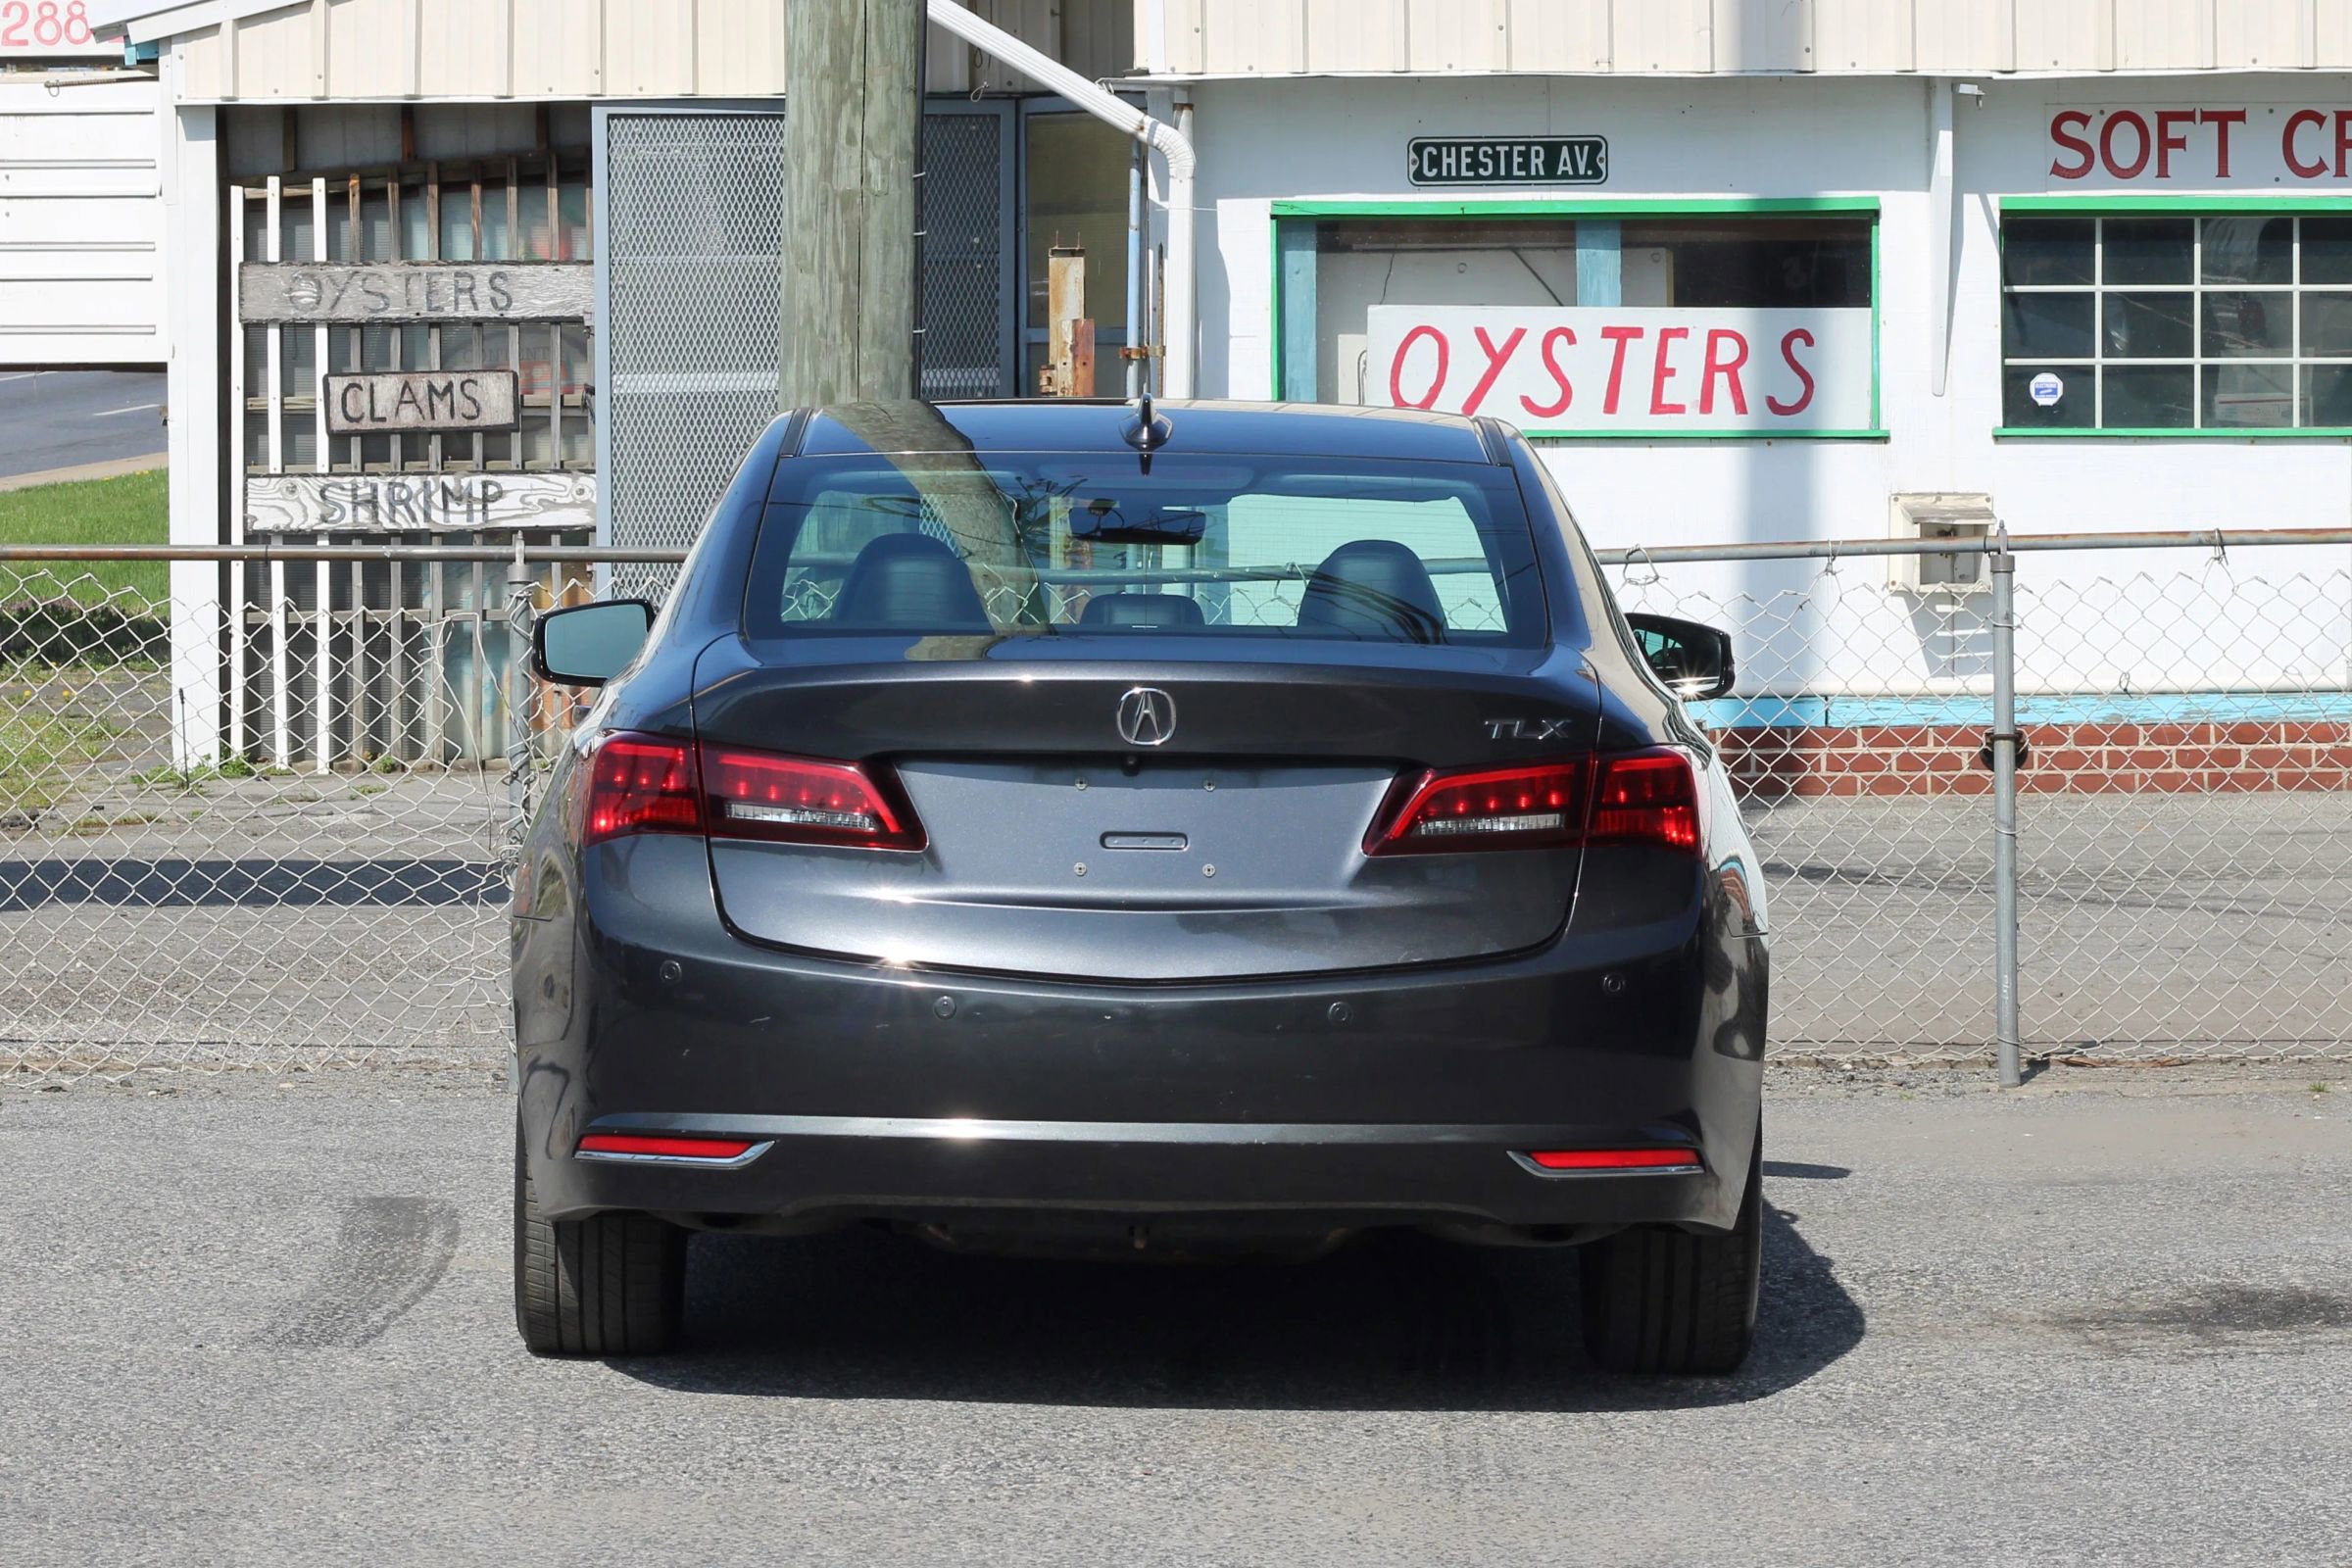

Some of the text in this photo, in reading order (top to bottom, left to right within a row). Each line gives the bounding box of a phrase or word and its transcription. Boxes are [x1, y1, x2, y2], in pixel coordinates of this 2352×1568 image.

[1, 0, 124, 46] 288
[1422, 145, 1592, 177] CHESTER AV.
[2049, 107, 2247, 179] SOFT
[287, 270, 514, 313] OYSTERS
[1389, 324, 1815, 418] OYSTERS
[340, 378, 481, 423] CLAMS
[318, 479, 503, 526] SHRIMP
[1484, 718, 1571, 740] TLX
